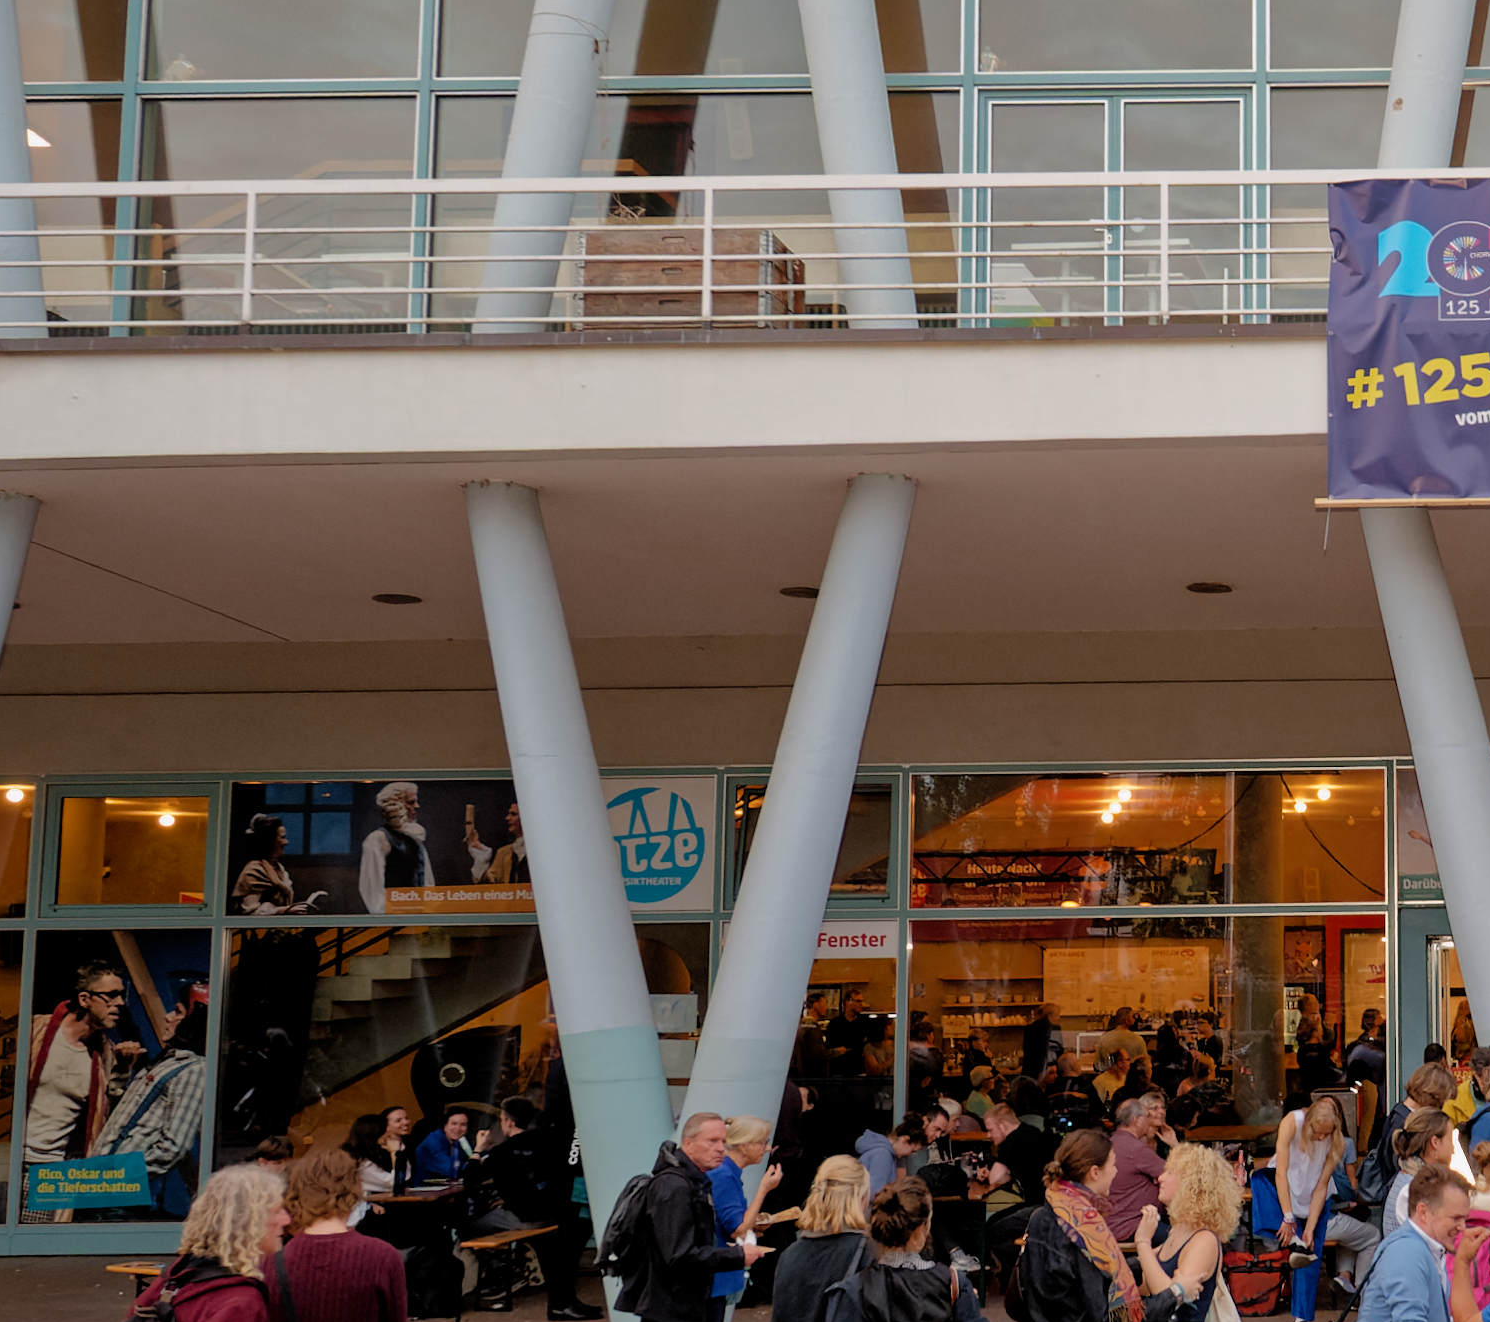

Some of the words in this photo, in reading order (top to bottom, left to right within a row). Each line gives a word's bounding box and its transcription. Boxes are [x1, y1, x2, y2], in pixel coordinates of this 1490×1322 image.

[1446, 300, 1479, 315] 125
[616, 832, 698, 872] tze
[391, 890, 421, 901] Bach.
[424, 891, 444, 901] Das
[447, 890, 481, 901] Leben
[483, 890, 514, 900] eines
[817, 932, 886, 948] Fenster
[38, 1169, 65, 1180] Rico,
[68, 1168, 100, 1179] Oskar
[103, 1168, 125, 1179] und
[37, 1182, 55, 1193] die
[58, 1182, 140, 1192] Tieferschatten
